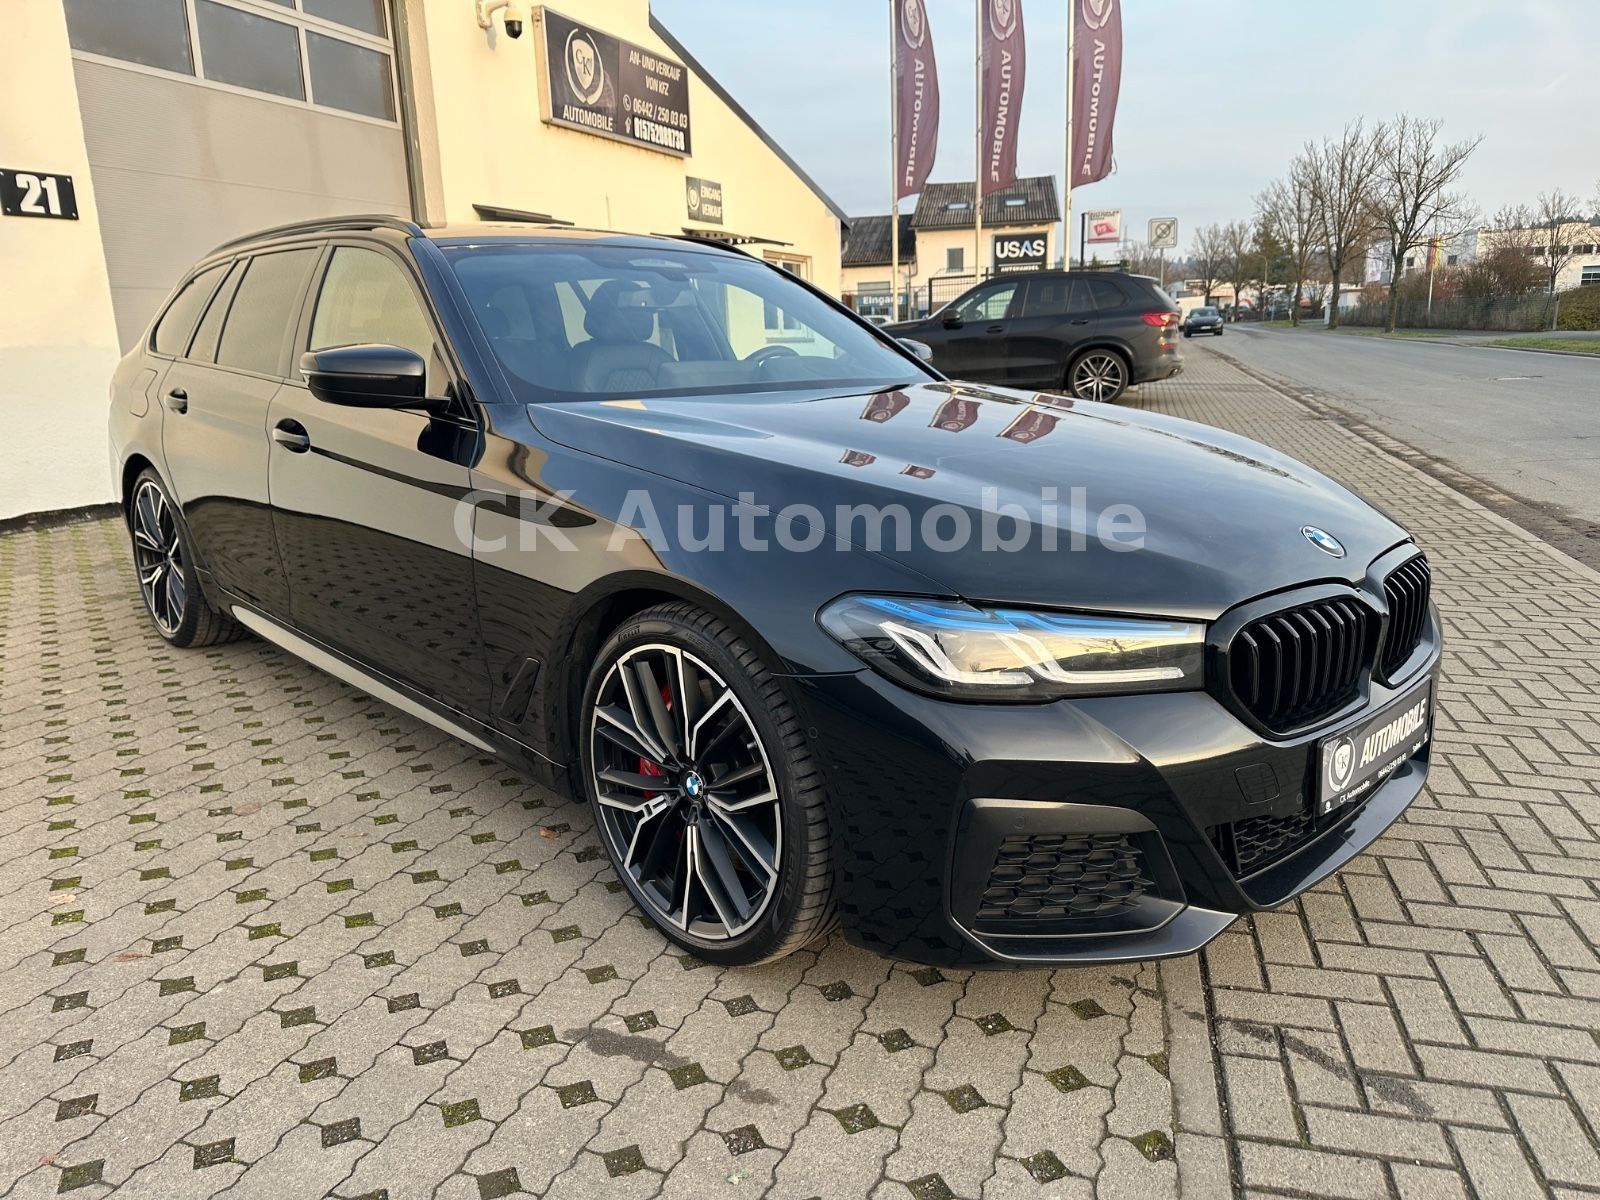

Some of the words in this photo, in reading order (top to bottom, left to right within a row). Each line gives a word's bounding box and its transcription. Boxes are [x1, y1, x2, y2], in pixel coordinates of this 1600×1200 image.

[629, 50, 642, 66] AN-
[642, 54, 655, 72] UND
[655, 57, 681, 81] VERKAUF
[645, 76, 659, 93] VON
[658, 80, 670, 96] KFZ
[563, 104, 614, 132] AUTOMOBILE
[633, 98, 652, 118] 06442
[657, 105, 670, 123] 250
[670, 110, 679, 126] 03
[679, 112, 688, 129] 03
[905, 58, 925, 188] AUTOMOBILE
[991, 50, 1012, 183] AUTOMOBILE
[1081, 39, 1105, 176] AUTOMOBILE
[15, 173, 62, 216] 21
[995, 239, 1045, 259] USAS
[1359, 698, 1426, 769] AUTOMOBILE
